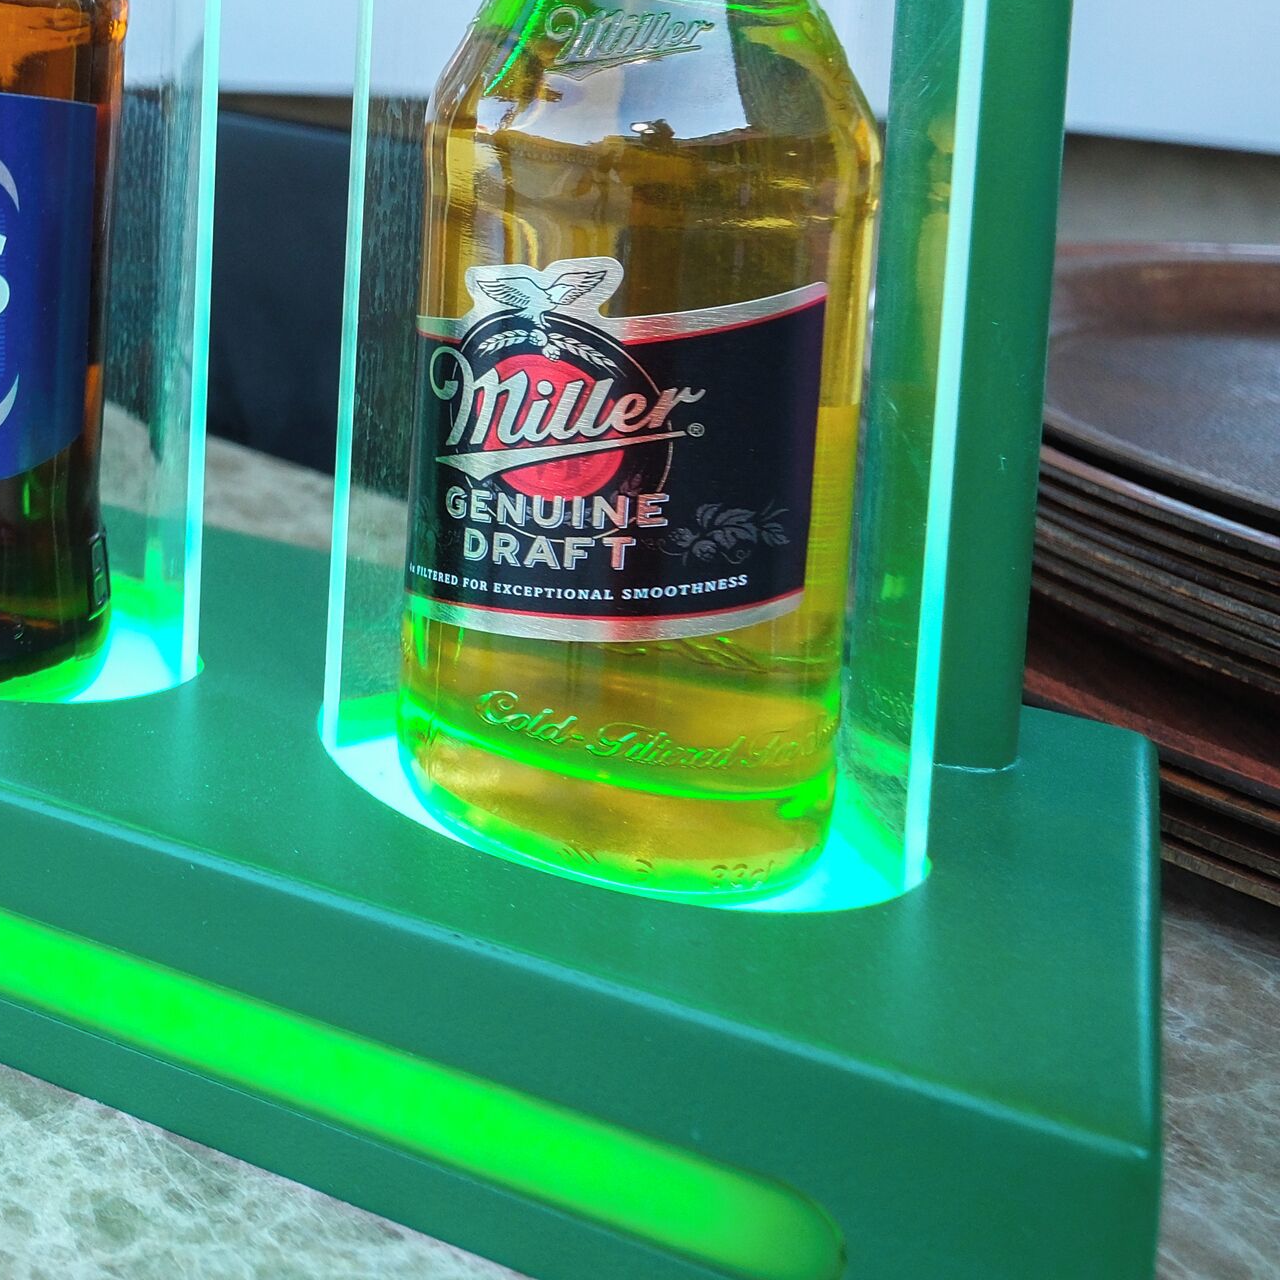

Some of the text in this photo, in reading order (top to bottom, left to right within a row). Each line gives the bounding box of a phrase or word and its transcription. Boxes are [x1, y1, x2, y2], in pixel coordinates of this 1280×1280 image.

[544, 4, 715, 64] Miller
[430, 346, 705, 447] Miller
[444, 485, 669, 527] GENUINE
[462, 532, 637, 571] DRAFT
[417, 565, 458, 586] FILTERED
[462, 578, 488, 592] FOR
[493, 583, 614, 600] EXCEPTIONAL
[621, 575, 749, 601] SMOOTHNESS
